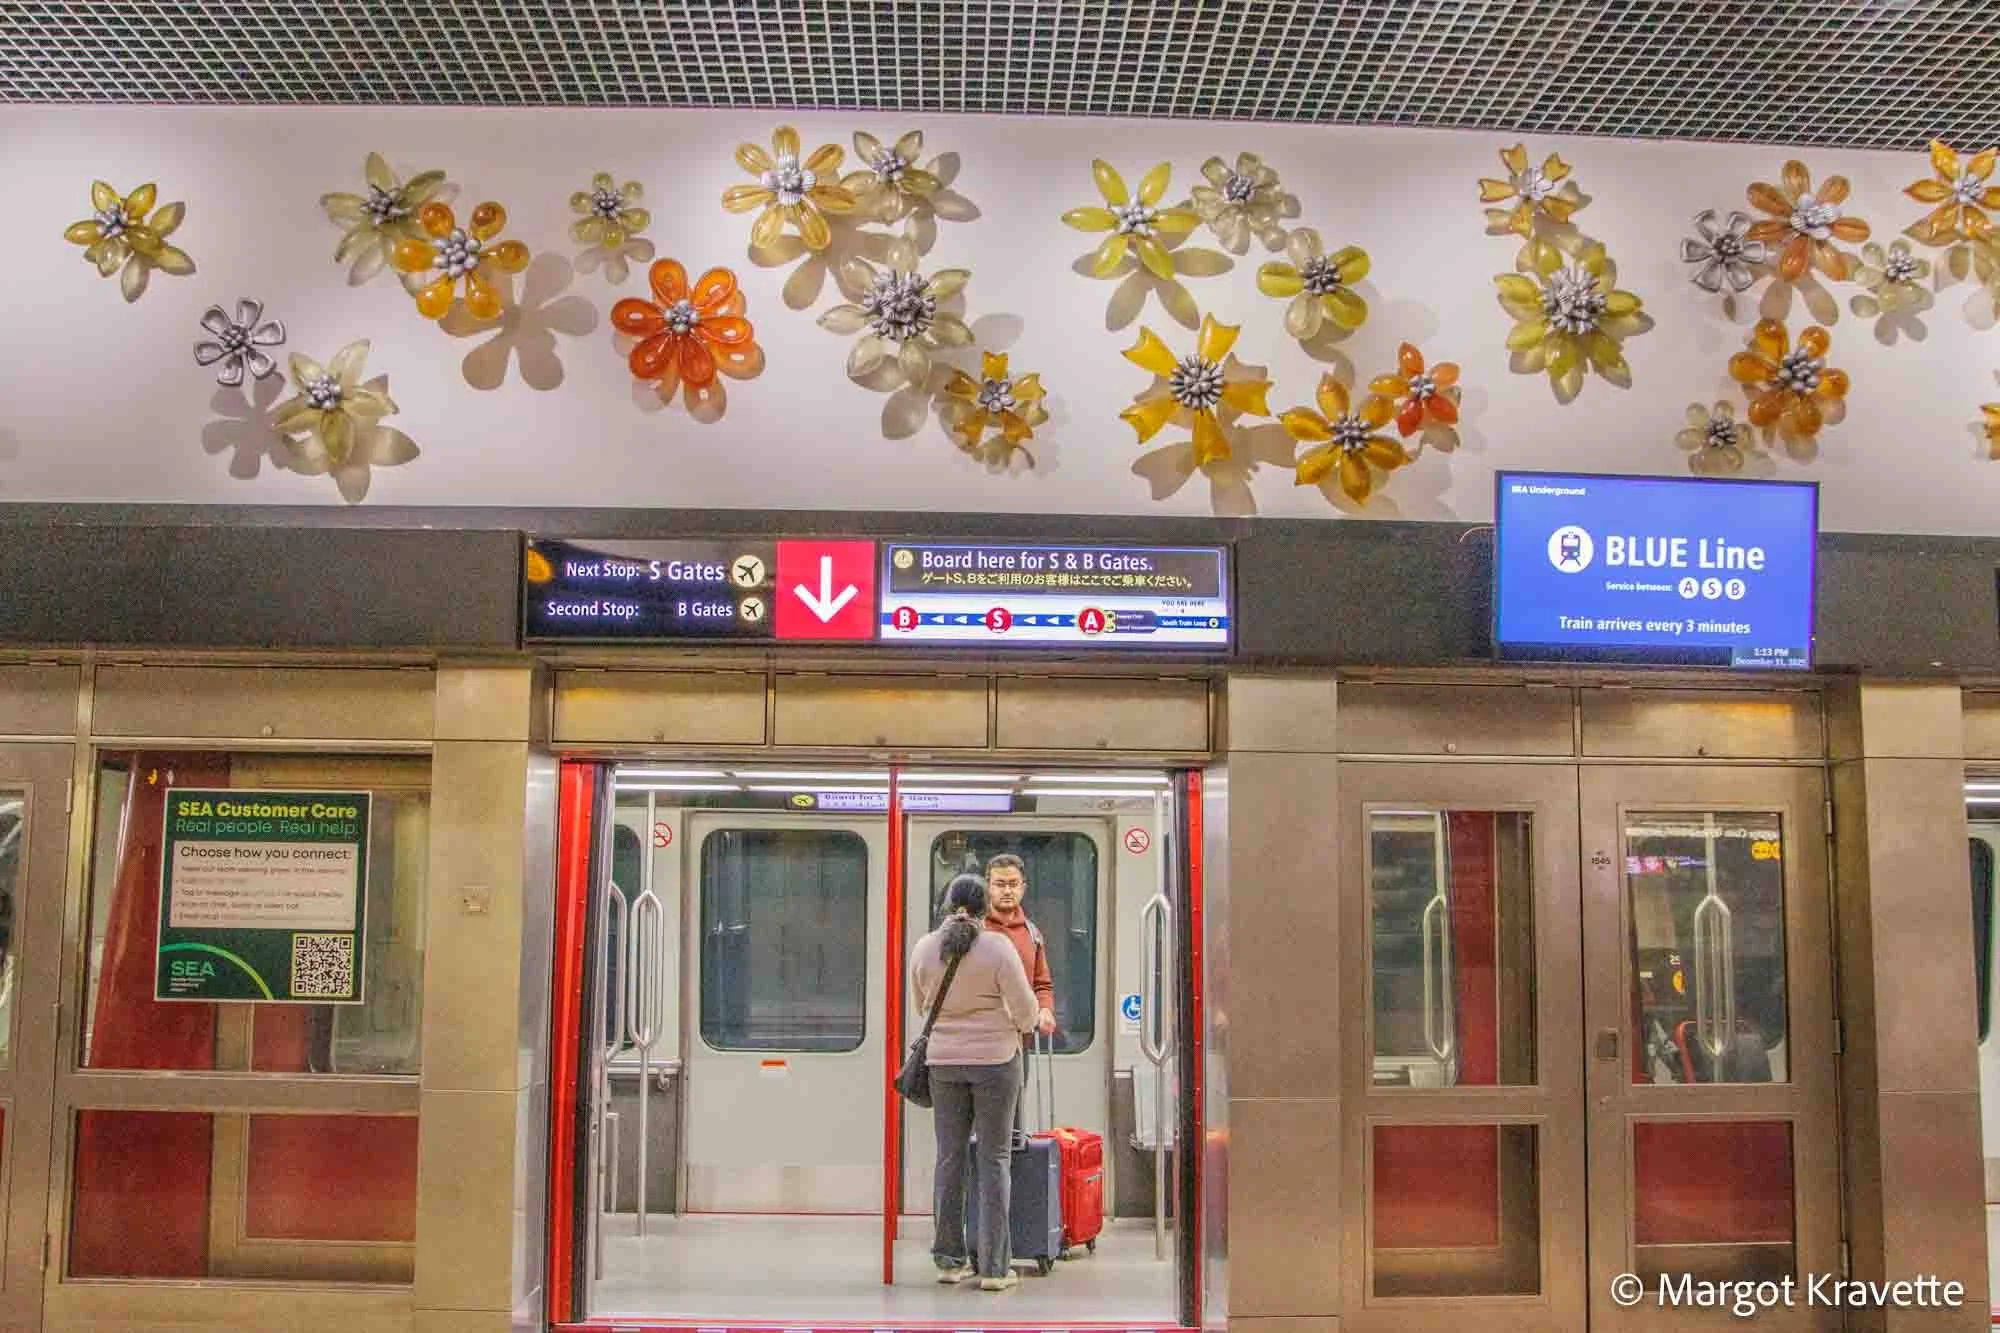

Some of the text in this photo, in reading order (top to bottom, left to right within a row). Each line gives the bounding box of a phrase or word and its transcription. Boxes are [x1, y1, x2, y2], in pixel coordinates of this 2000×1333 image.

[1529, 486, 1586, 496] Underground
[922, 551, 1153, 570] Board here for S & B Gates.
[1605, 535, 1766, 570] BLUE Line
[566, 561, 725, 581] Next Stop: S Gates
[1605, 581, 1635, 592] Service
[1682, 582, 1694, 594] A
[1707, 582, 1717, 596] S
[1731, 583, 1740, 596] B
[548, 602, 733, 620] Second Stop: B Gates
[900, 610, 911, 625] B
[992, 611, 1004, 627] S
[1084, 612, 1099, 628] A
[1559, 616, 1751, 636] Train arrives every 3 minutes
[1774, 648, 1789, 656] PM
[178, 801, 357, 818] SEA Customer Care
[176, 818, 211, 833] Real
[280, 820, 314, 834] Real
[180, 846, 352, 861] Choose how you connect:
[170, 960, 217, 976] SEA
